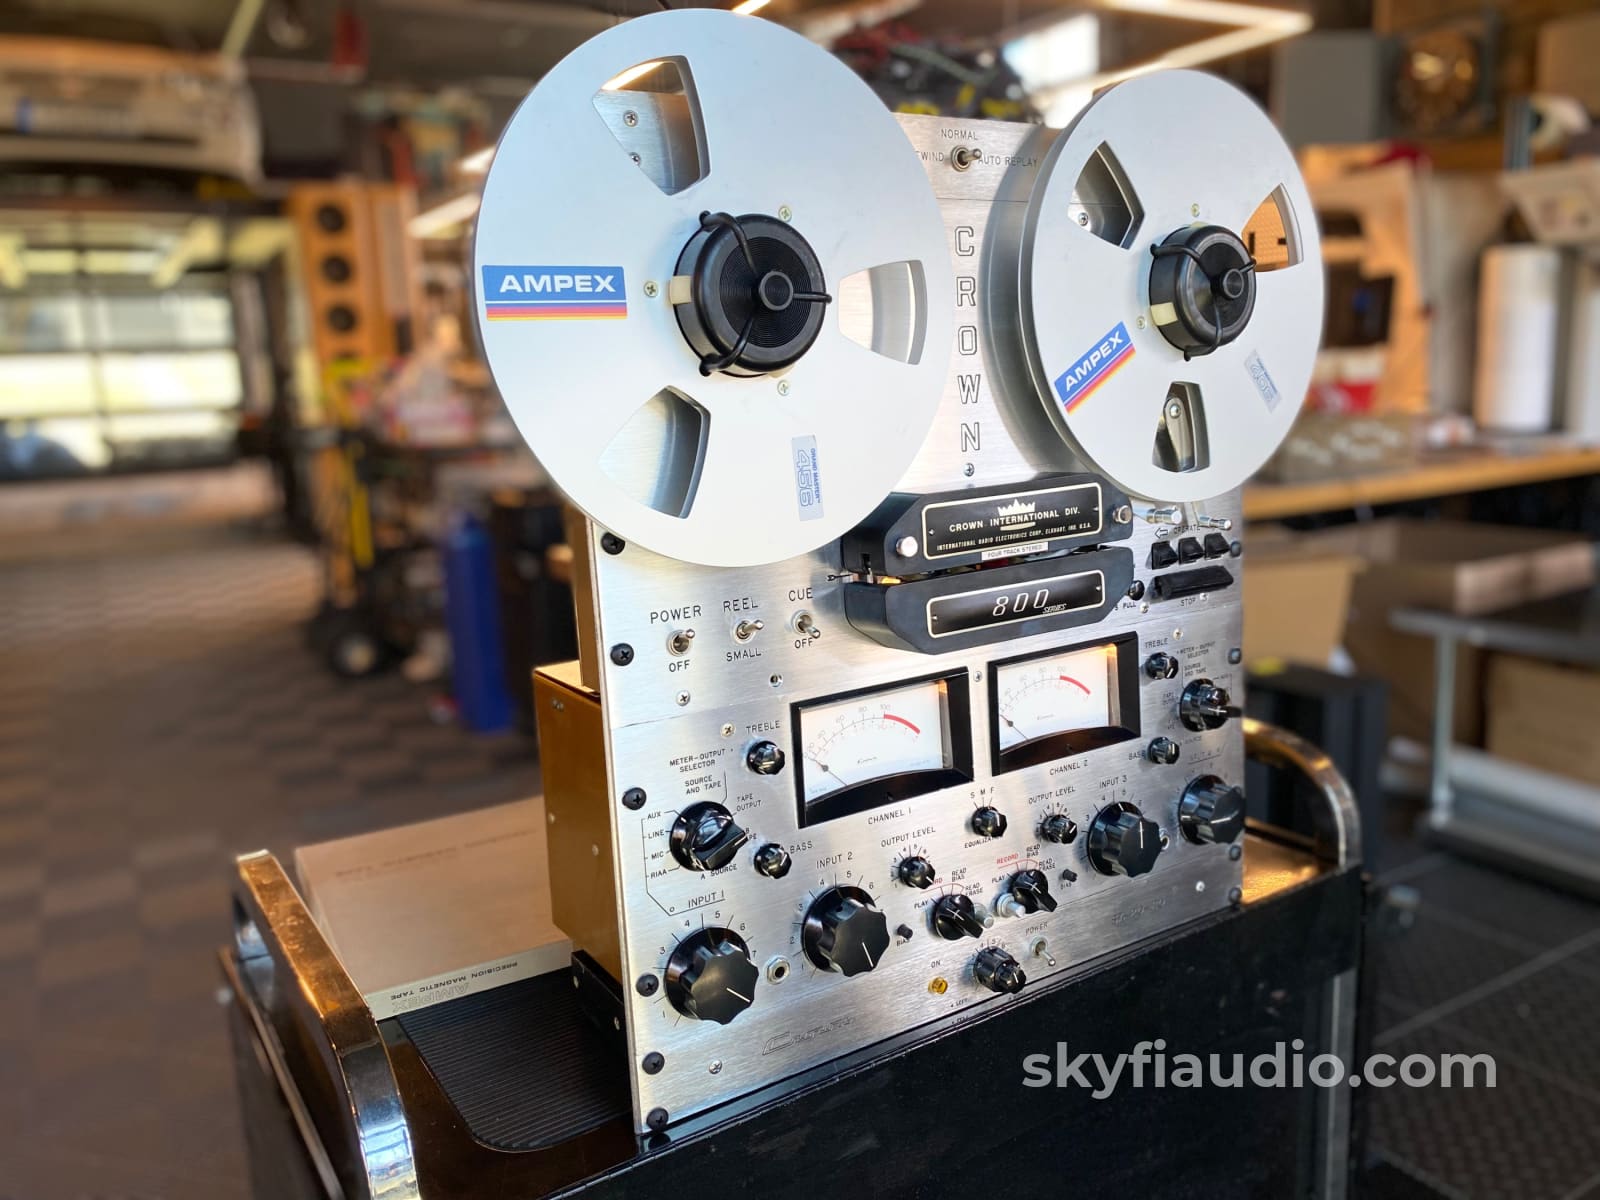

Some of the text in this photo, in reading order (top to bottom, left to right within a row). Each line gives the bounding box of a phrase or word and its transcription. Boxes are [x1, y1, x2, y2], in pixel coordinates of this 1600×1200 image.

[941, 129, 978, 140] NORMAL
[915, 151, 944, 161] WIND
[978, 155, 1037, 167] AUTO REPLAY
[500, 274, 616, 293] AMPEX
[954, 226, 980, 452] CROWN
[1065, 331, 1124, 392] AMPEX
[797, 450, 813, 506] 456
[950, 507, 1080, 532] CROWN INTERNATIONAL DIV.
[789, 587, 813, 602] CUE
[723, 598, 759, 612] REEL
[992, 589, 1049, 616] 800
[1180, 597, 1196, 606] STOP
[650, 605, 702, 624] POWER
[794, 638, 813, 649] OFF
[1145, 638, 1168, 648] TREBLE
[726, 649, 762, 662] SMALL
[669, 660, 690, 672] OFF
[746, 720, 781, 733] TREBLE
[679, 760, 716, 773] SELECTOR
[1050, 762, 1080, 775] CHANNEL
[685, 775, 712, 787] SOURCE
[705, 781, 721, 790] TAPE
[1100, 777, 1119, 788] INPUT
[737, 794, 753, 802] TAPE
[1029, 787, 1076, 804] OUTPUT LEVEL
[737, 801, 762, 811] OUTPUT
[647, 812, 661, 820] AUX
[868, 810, 904, 824] CHANNEL
[648, 830, 664, 840] LINE
[881, 827, 936, 847] OUTPUT LEVEL
[790, 841, 813, 854] BASS
[652, 851, 664, 859] MIC
[816, 852, 853, 868] INPUT 2
[997, 854, 1018, 864] RECORD
[651, 869, 667, 879] RIAA
[711, 864, 737, 877] SOURCE
[688, 893, 716, 908] INPUT
[740, 923, 745, 931] 6
[1026, 922, 1048, 935] POWER
[931, 960, 941, 968] ON
[390, 962, 518, 1000] PRECISION MAGNETIC TAPE
